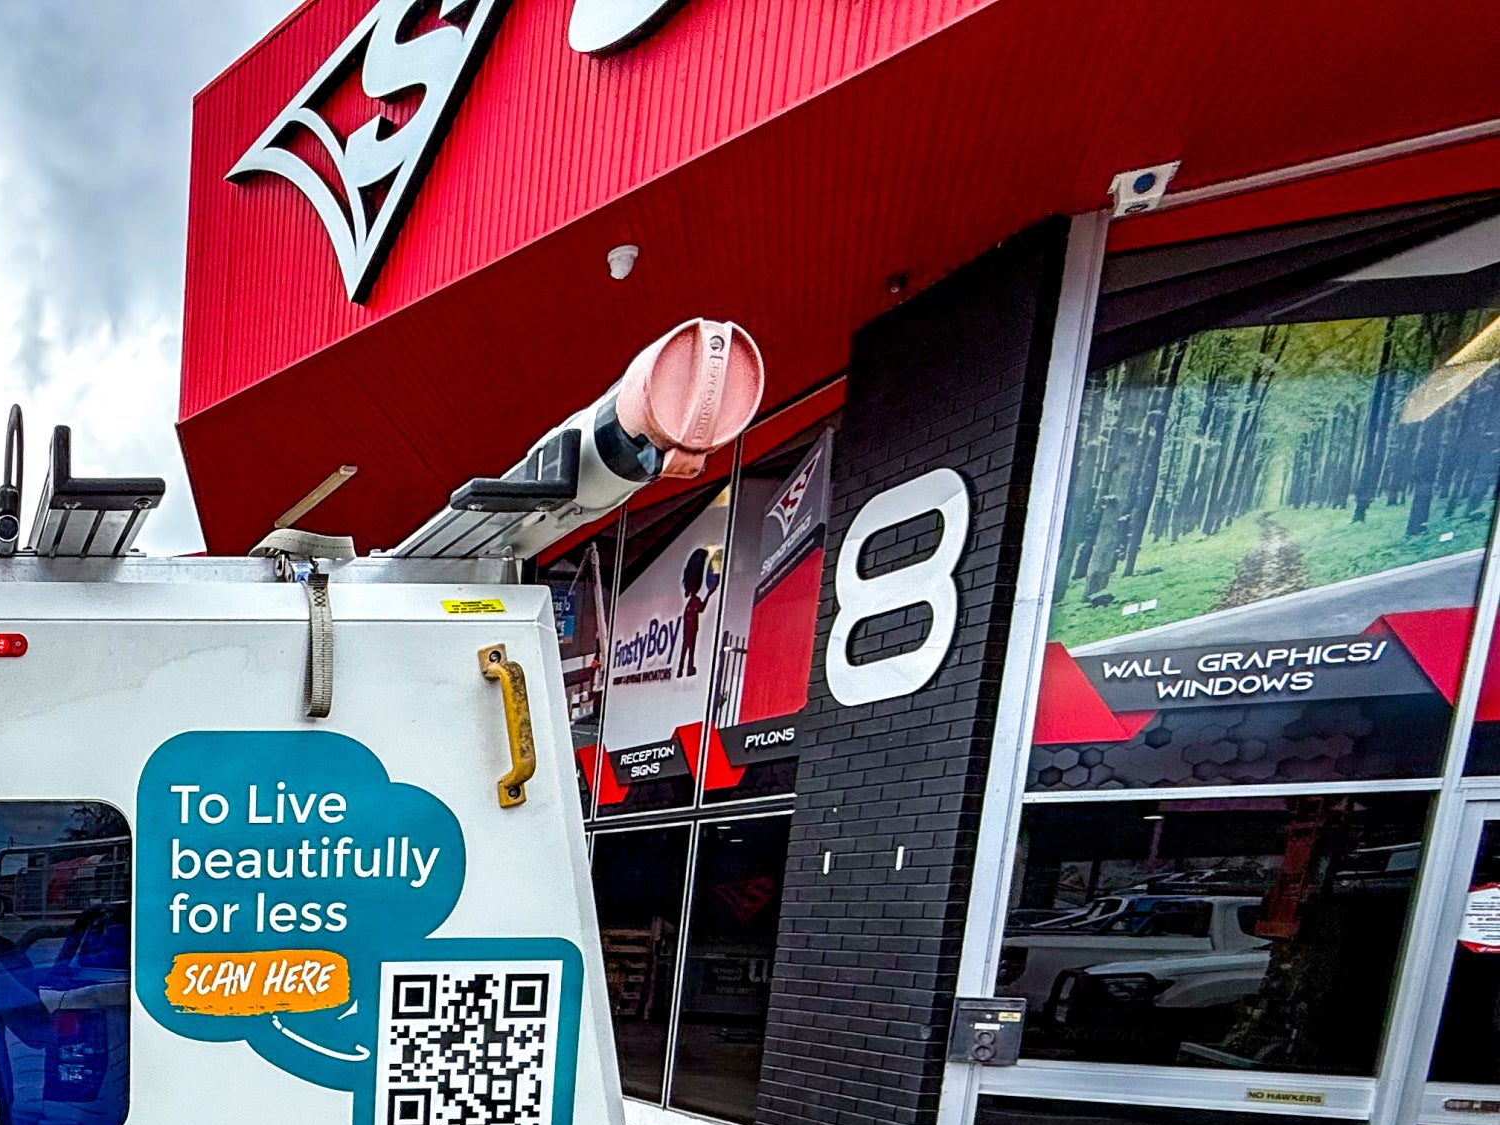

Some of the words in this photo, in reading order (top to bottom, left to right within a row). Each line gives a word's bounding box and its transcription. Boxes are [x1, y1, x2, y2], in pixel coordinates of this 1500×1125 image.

[825, 466, 972, 708] 8
[1102, 657, 1181, 679] WALL
[1197, 641, 1388, 673] GRAPHICS/
[1156, 671, 1315, 699] WINDOWS
[620, 744, 675, 766] RECEPTION
[744, 727, 795, 749] PYLONS
[630, 762, 661, 778] SIGNS
[170, 784, 230, 824] To
[249, 781, 347, 824] Live
[171, 836, 441, 888] beautifully
[169, 892, 240, 933] for
[257, 892, 348, 932] less
[182, 961, 256, 997] SCAN
[263, 959, 337, 996] HERE
[1247, 1090, 1264, 1099] NO
[1267, 1092, 1322, 1103] HAWKERS
